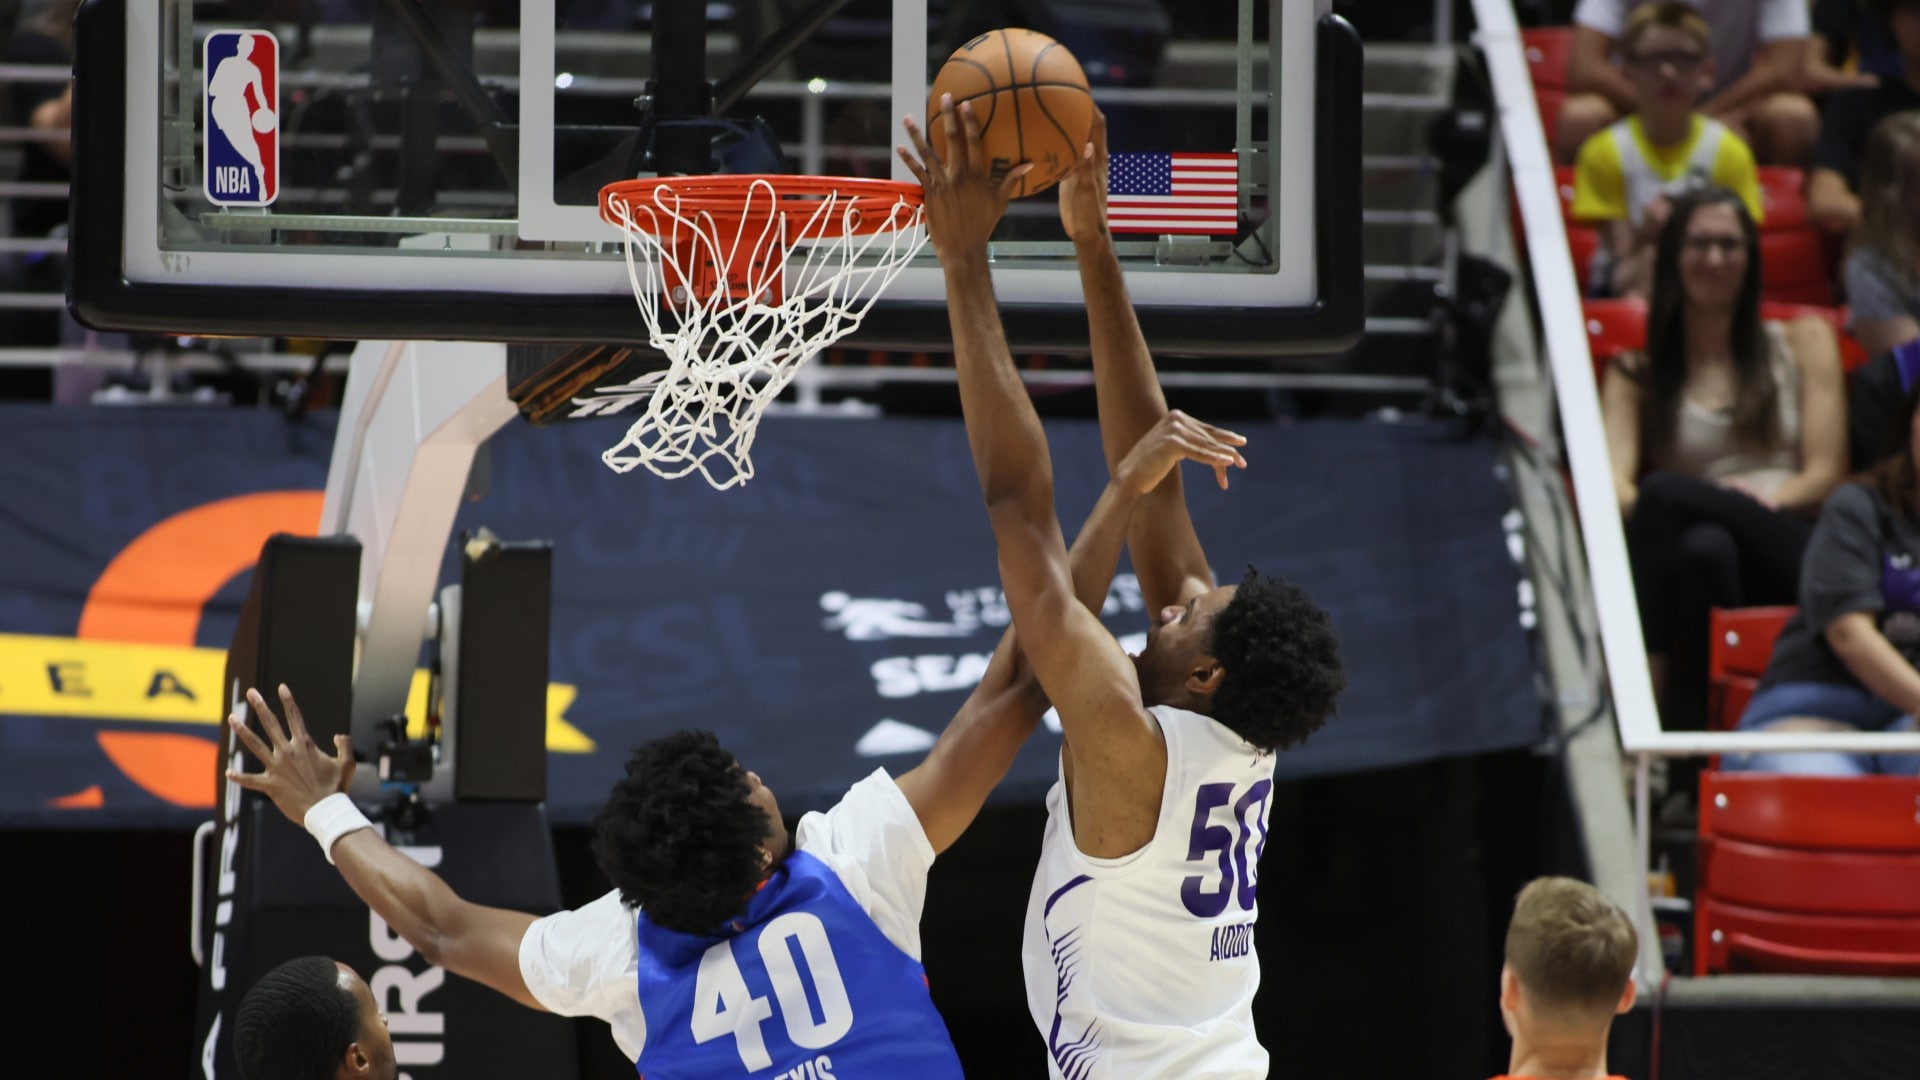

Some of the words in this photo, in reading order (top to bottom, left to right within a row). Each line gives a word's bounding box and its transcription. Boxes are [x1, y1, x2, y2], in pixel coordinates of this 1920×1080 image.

[215, 166, 251, 194] NBA
[1180, 778, 1272, 918] 50
[690, 911, 854, 1074] 40
